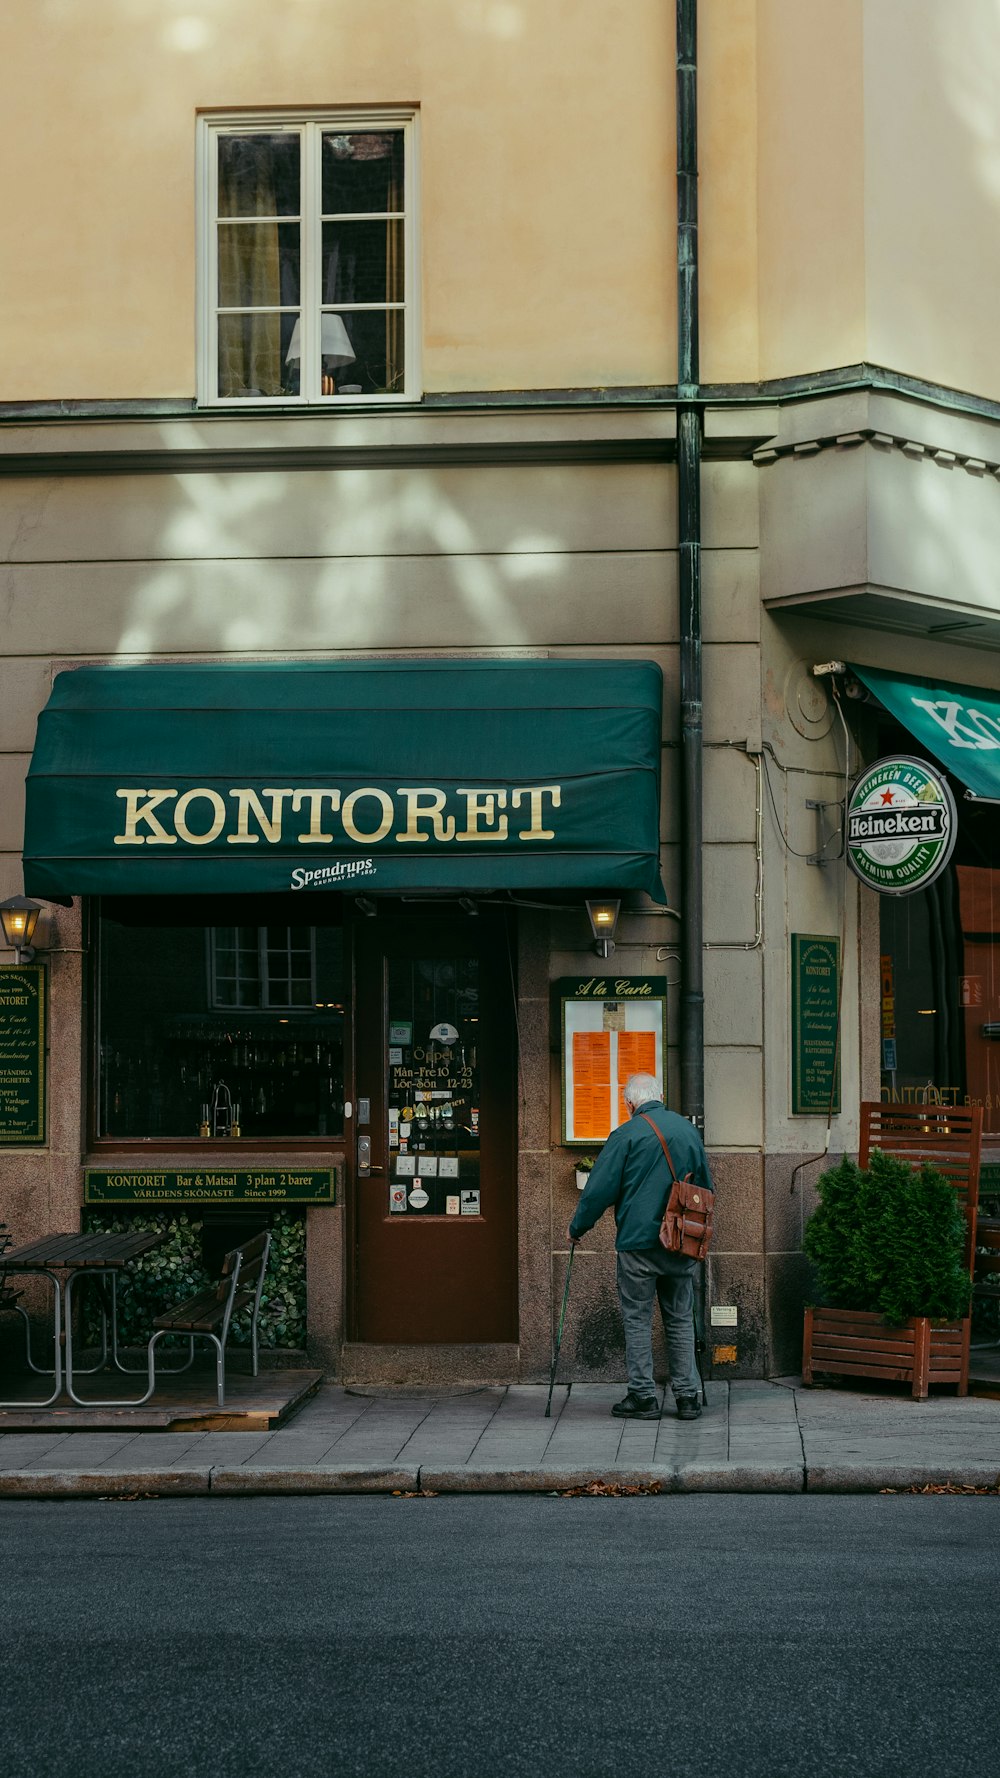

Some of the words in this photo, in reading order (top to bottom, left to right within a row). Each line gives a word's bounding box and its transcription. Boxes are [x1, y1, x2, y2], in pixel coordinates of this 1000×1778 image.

[859, 770, 902, 799] HEINEKEN
[903, 772, 926, 793] BEER
[113, 785, 561, 845] KONTORET
[850, 811, 937, 838] Heineken
[856, 852, 895, 879] PREMIUM
[896, 846, 931, 878] QUALITY
[290, 858, 373, 890] Spendrups
[313, 876, 346, 886] GRUNDAT
[592, 980, 608, 995] la
[614, 979, 652, 995] Carte
[9, 1014, 28, 1023] Carte
[4, 1098, 30, 1106] Vardagar
[4, 1105, 19, 1113] Helg
[106, 1175, 167, 1187] KONTORET
[176, 1175, 194, 1186] Bar
[194, 1175, 204, 1186] &
[206, 1175, 237, 1186] Matsal
[246, 1175, 253, 1185] 3
[255, 1175, 276, 1188] plan
[280, 1175, 287, 1185] 2
[288, 1176, 313, 1186] barer
[133, 1189, 182, 1198] VÄRLDENS
[184, 1188, 235, 1198] SKÖNASTE
[244, 1189, 267, 1198] Since
[268, 1189, 287, 1198] 1999
